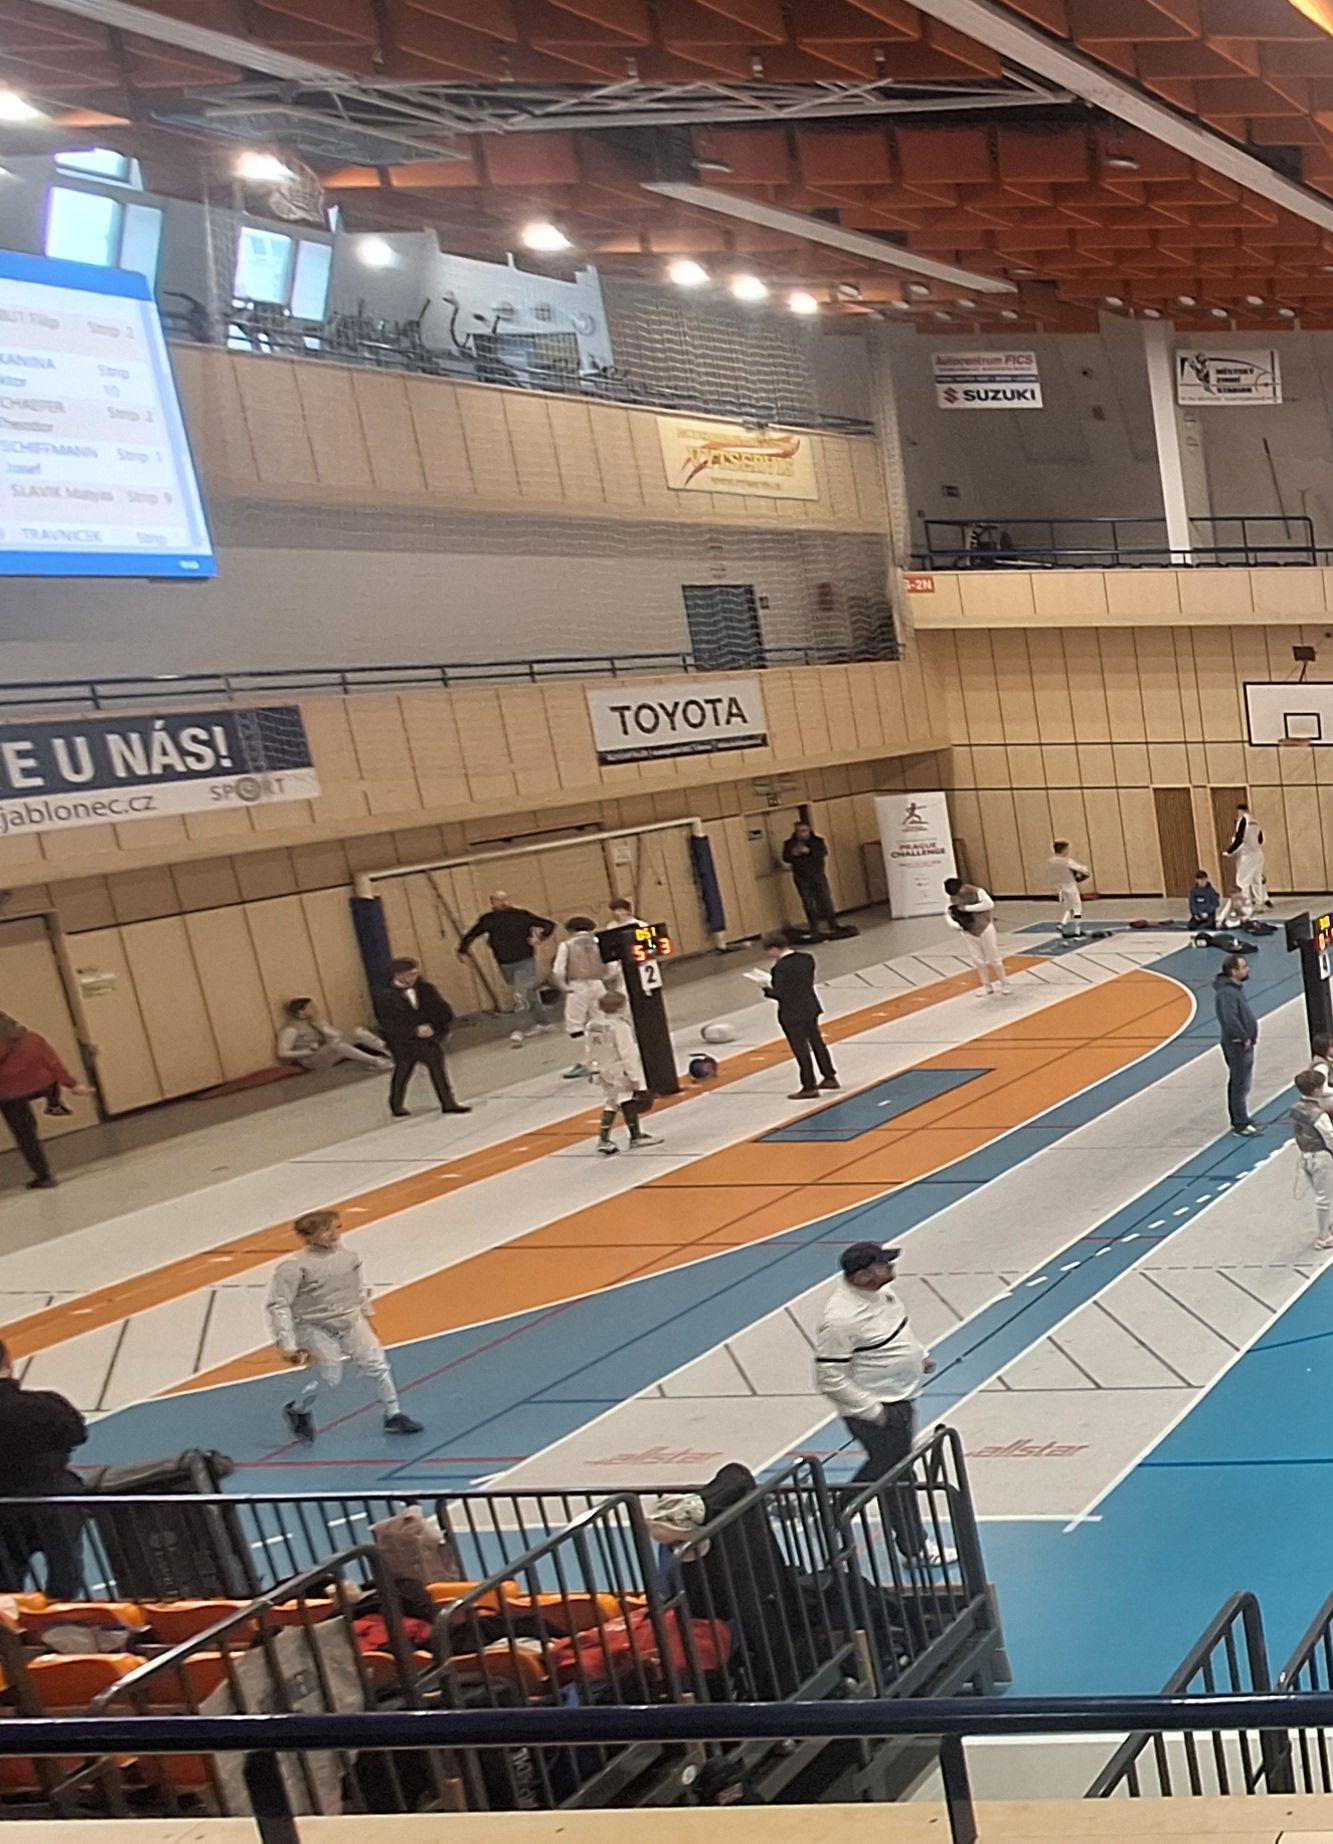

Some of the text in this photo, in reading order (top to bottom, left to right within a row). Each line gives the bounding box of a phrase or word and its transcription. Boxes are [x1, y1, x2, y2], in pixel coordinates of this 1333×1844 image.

[963, 389, 1037, 402] SUZUKI
[609, 697, 748, 736] TOYOTA
[52, 736, 96, 783] U
[106, 719, 234, 779] NÁS!
[210, 777, 286, 802] SPORT
[891, 848, 945, 859] CHALLENGE
[632, 944, 647, 961] 5
[659, 937, 673, 955] 3
[644, 965, 657, 984] 2
[972, 1438, 1090, 1458] allstar
